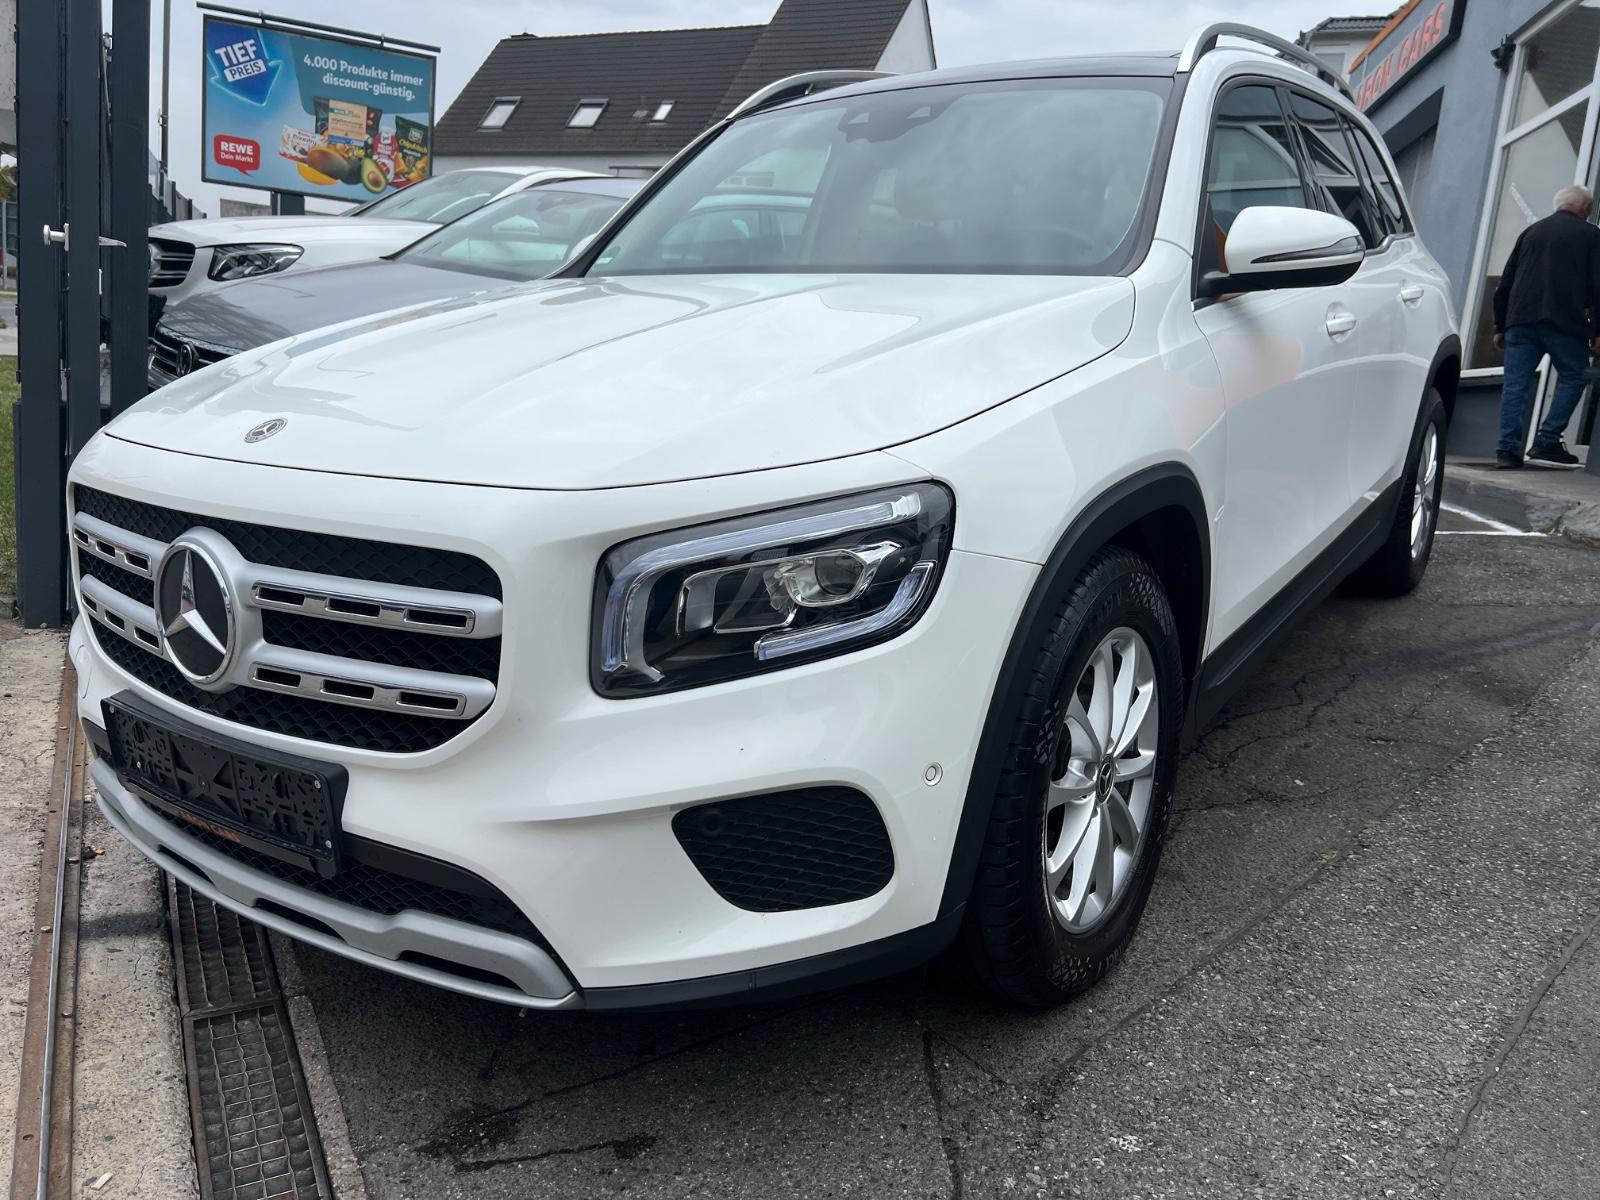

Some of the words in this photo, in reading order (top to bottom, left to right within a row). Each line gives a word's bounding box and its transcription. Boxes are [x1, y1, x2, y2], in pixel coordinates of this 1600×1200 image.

[215, 39, 257, 68] TIEF
[228, 61, 262, 80] PREIS
[303, 53, 337, 71] 4.000
[340, 62, 388, 81] Produkte
[390, 70, 424, 87] immer
[322, 73, 416, 101] discount-günstig.
[220, 140, 254, 156] REWE
[220, 151, 236, 161] Dein
[237, 153, 254, 164] Markt
